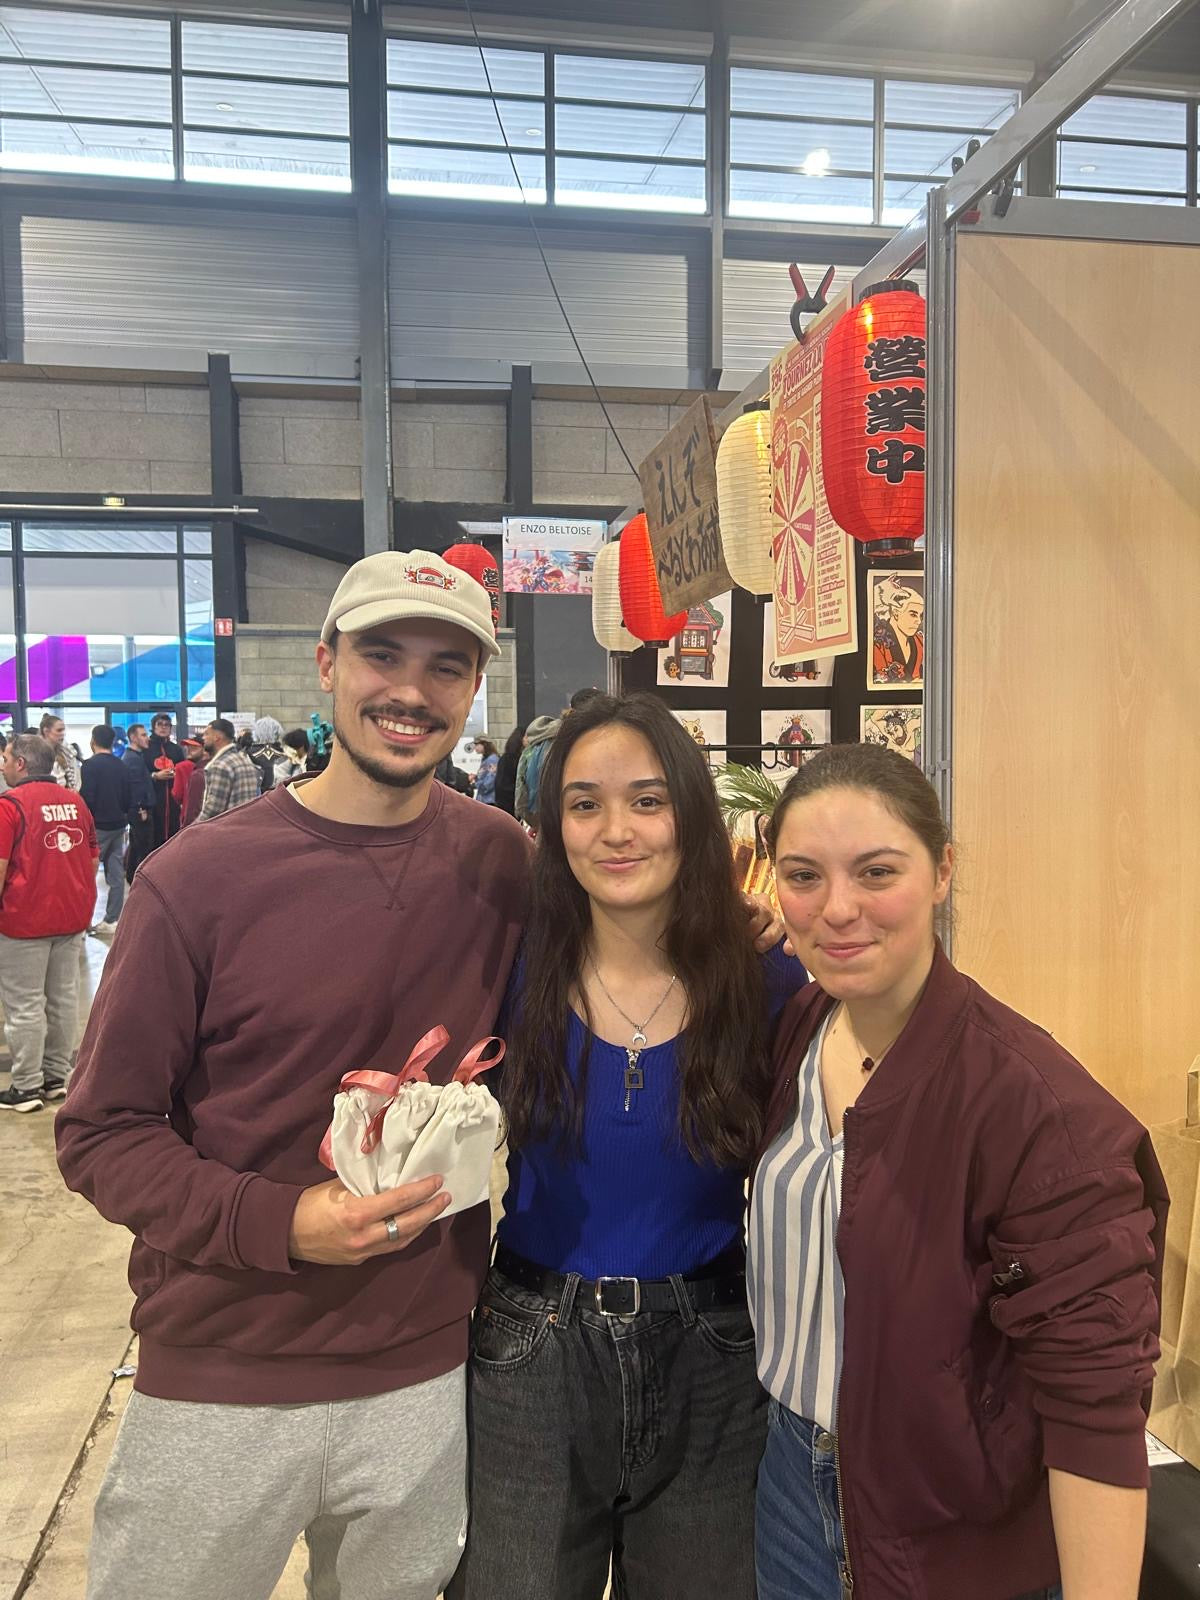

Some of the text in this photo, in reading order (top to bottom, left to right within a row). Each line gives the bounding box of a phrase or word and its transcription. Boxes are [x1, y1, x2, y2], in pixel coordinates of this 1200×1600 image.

[783, 352, 814, 399] TOURNEZ
[520, 524, 592, 535] ENZO BELTOISE
[41, 803, 78, 822] STAFF
